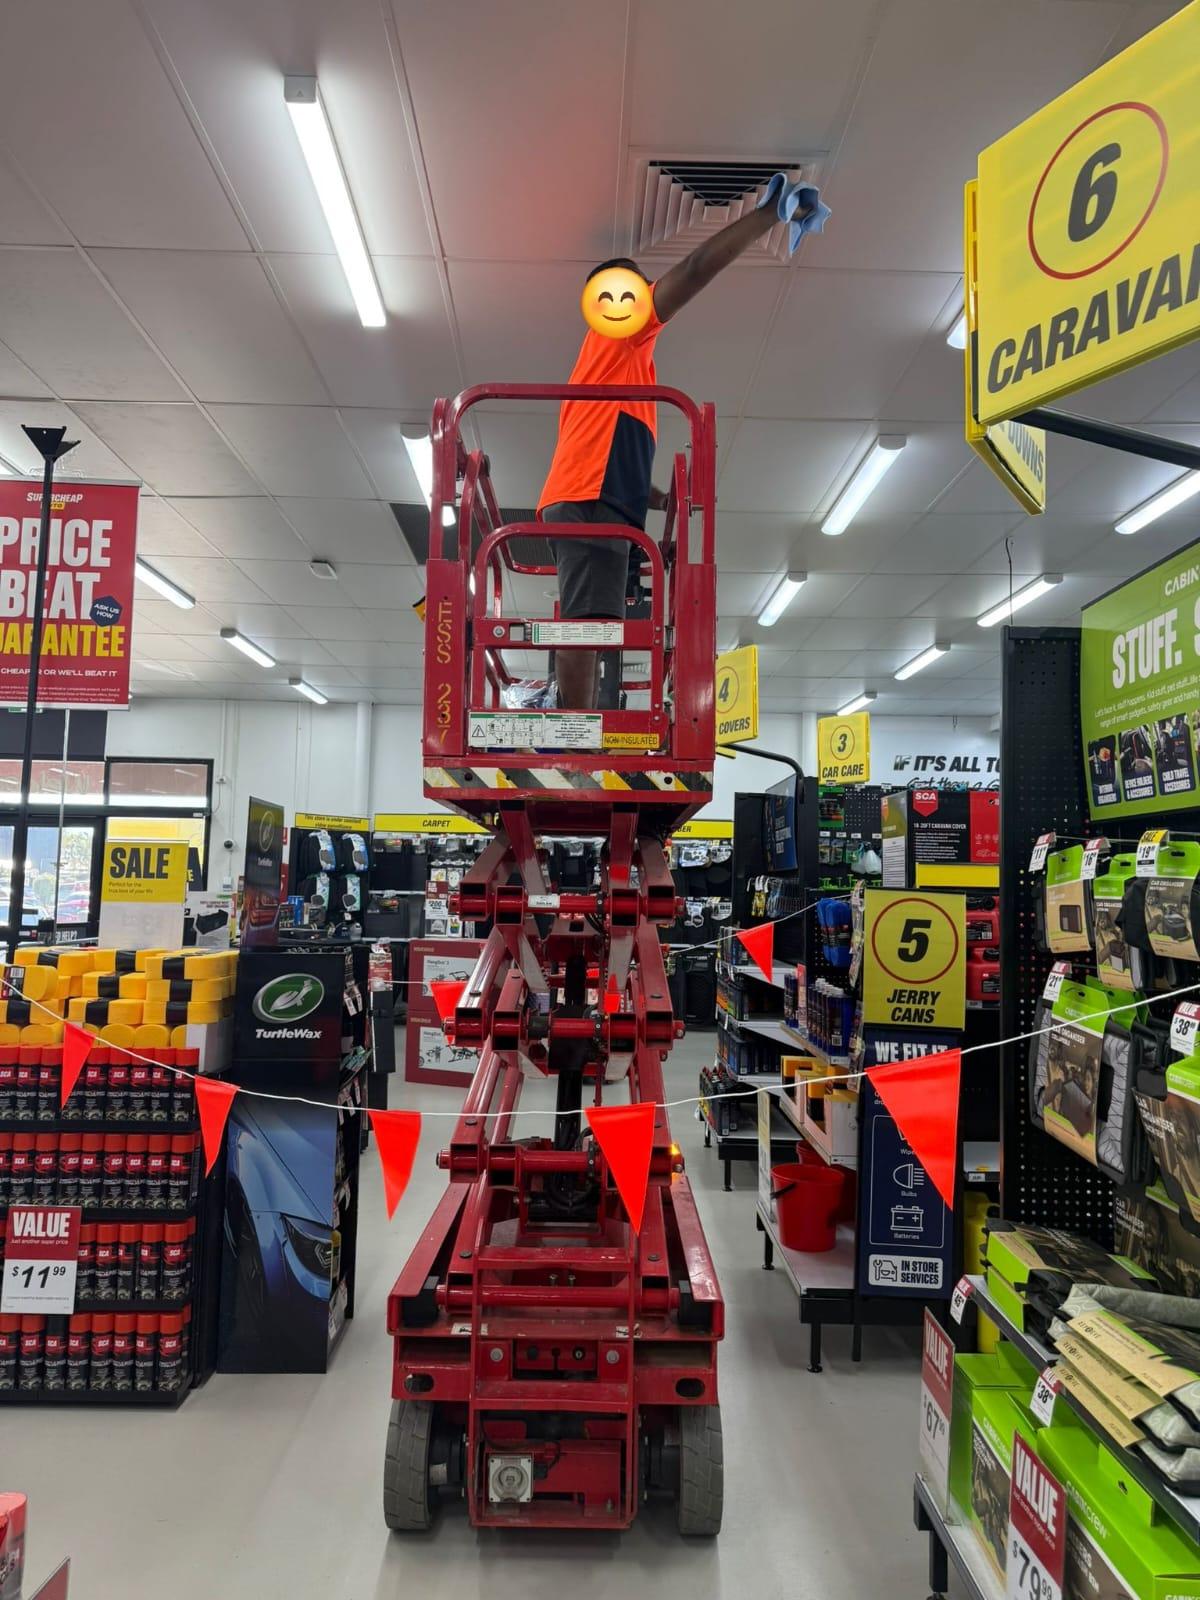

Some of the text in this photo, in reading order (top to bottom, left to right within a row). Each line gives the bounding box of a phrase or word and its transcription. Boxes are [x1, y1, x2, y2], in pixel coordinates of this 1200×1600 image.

[1068, 142, 1122, 242] 6
[0, 516, 113, 567] PRICE
[94, 603, 109, 612] ASK
[96, 610, 114, 619] HOW
[1112, 608, 1182, 689] STUFF.
[718, 677, 730, 702] 4
[718, 717, 750, 735] COVERS
[837, 733, 847, 752] 3
[822, 763, 865, 779] CAR CARE
[894, 755, 911, 771] IF
[914, 755, 947, 771] IT'S
[949, 756, 981, 772] ALL
[915, 792, 937, 800] SCA
[109, 847, 170, 879] SALE
[898, 918, 932, 963] 5
[887, 989, 941, 1006] JERRY
[891, 1007, 935, 1024] CANS
[256, 1028, 322, 1039] TurtleWax
[874, 1041, 899, 1063] WE
[13, 1212, 71, 1237] VALUE
[894, 1232, 920, 1240] Batteries
[901, 1260, 939, 1273] IN STORE
[901, 1271, 939, 1286] SERVICES
[1015, 1442, 1058, 1538] VALUE
